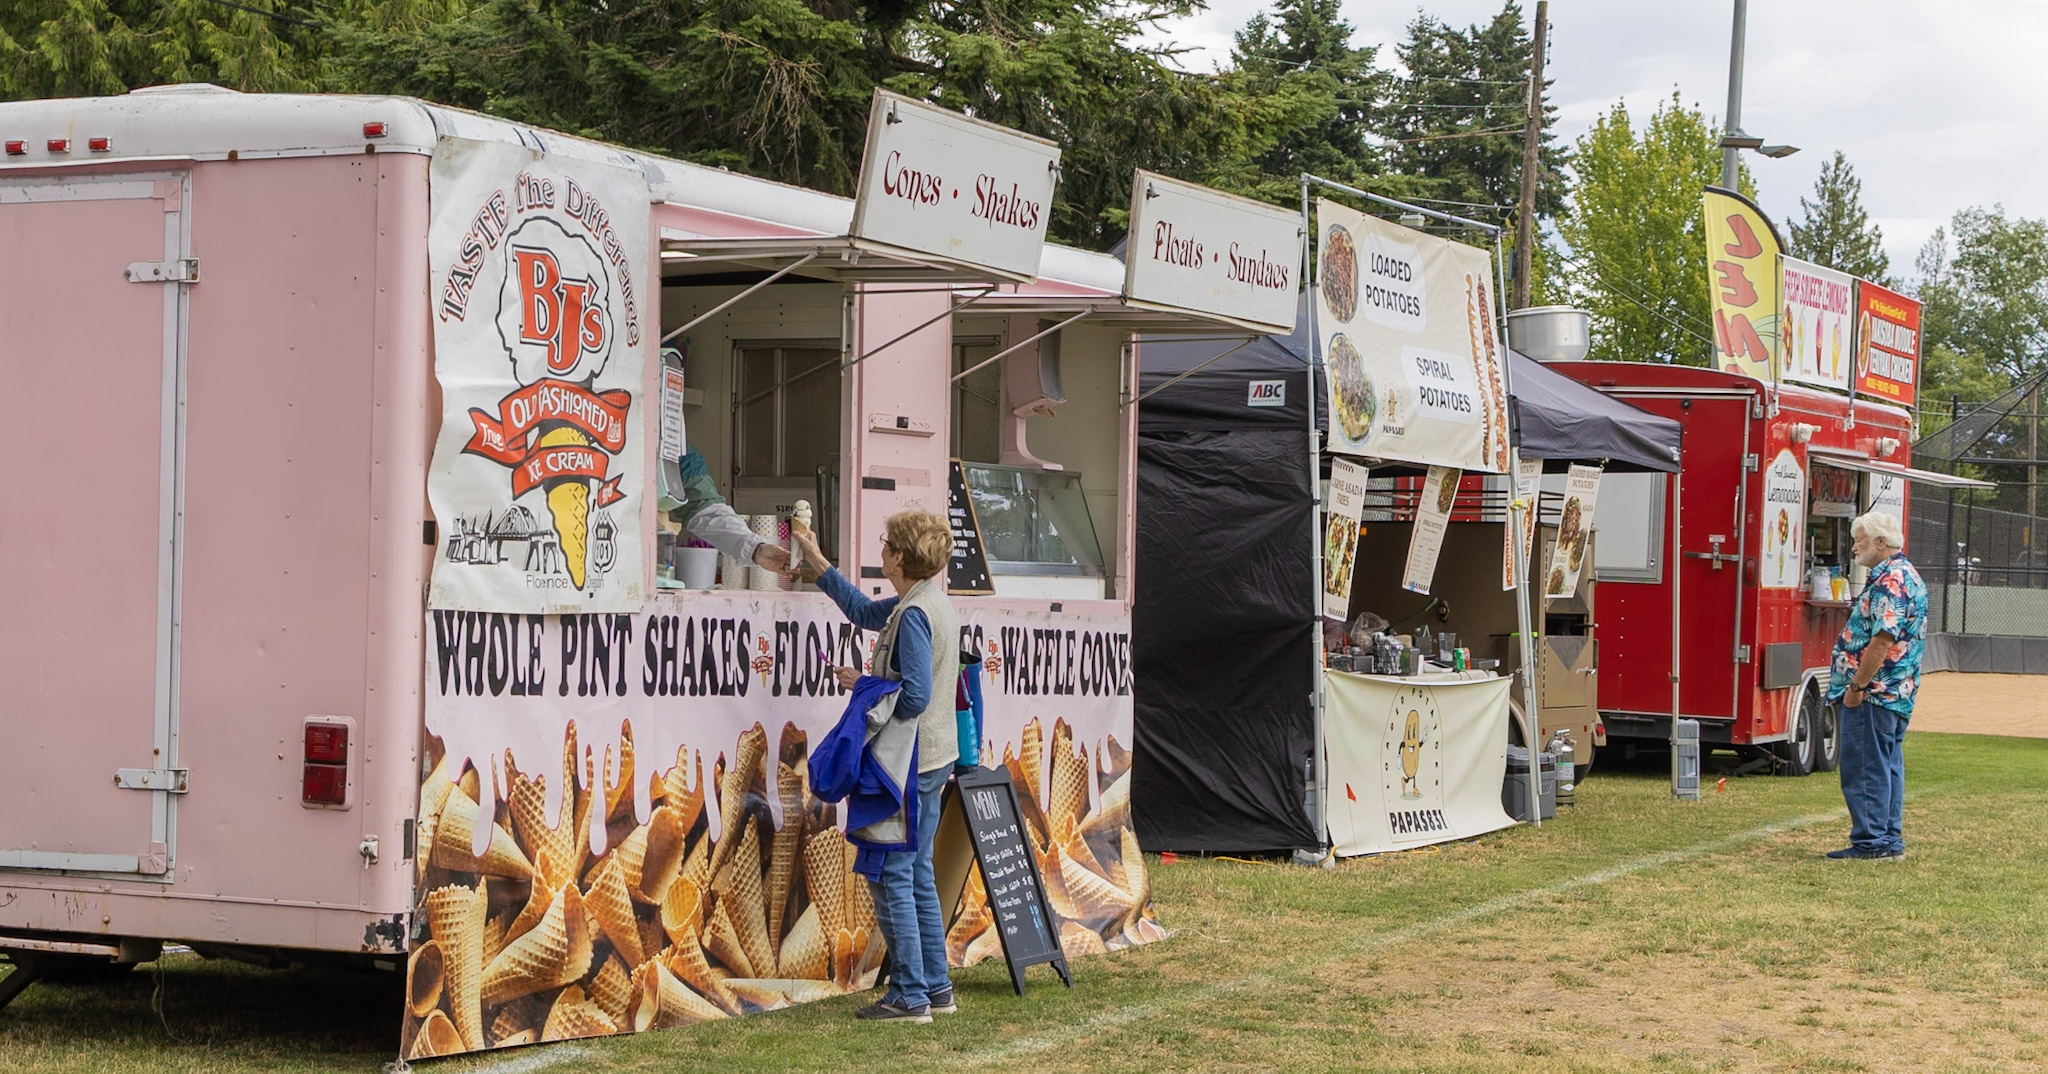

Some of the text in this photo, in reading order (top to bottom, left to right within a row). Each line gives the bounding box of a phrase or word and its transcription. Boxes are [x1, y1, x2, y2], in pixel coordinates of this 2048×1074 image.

[884, 150, 1039, 231] Cones Shakes
[440, 171, 640, 347] TASTE The Difference
[1153, 220, 1288, 293] Floats Sundaes
[1371, 252, 1412, 282] LOADED
[1366, 284, 1421, 317] POTATOES
[1416, 357, 1455, 382] SPIRAL
[1253, 384, 1282, 398] ABC
[1419, 386, 1471, 414] POTATOES
[538, 382, 607, 433] FASHIONED
[480, 422, 504, 448] True
[528, 451, 594, 483] ICE CREAM
[433, 610, 750, 697] WHOLE PINT SHAKES
[772, 621, 863, 697] FLOATS
[1001, 626, 1076, 695] WAFFLE
[972, 790, 1001, 820] MENU
[1389, 809, 1448, 834] PAPAS831
